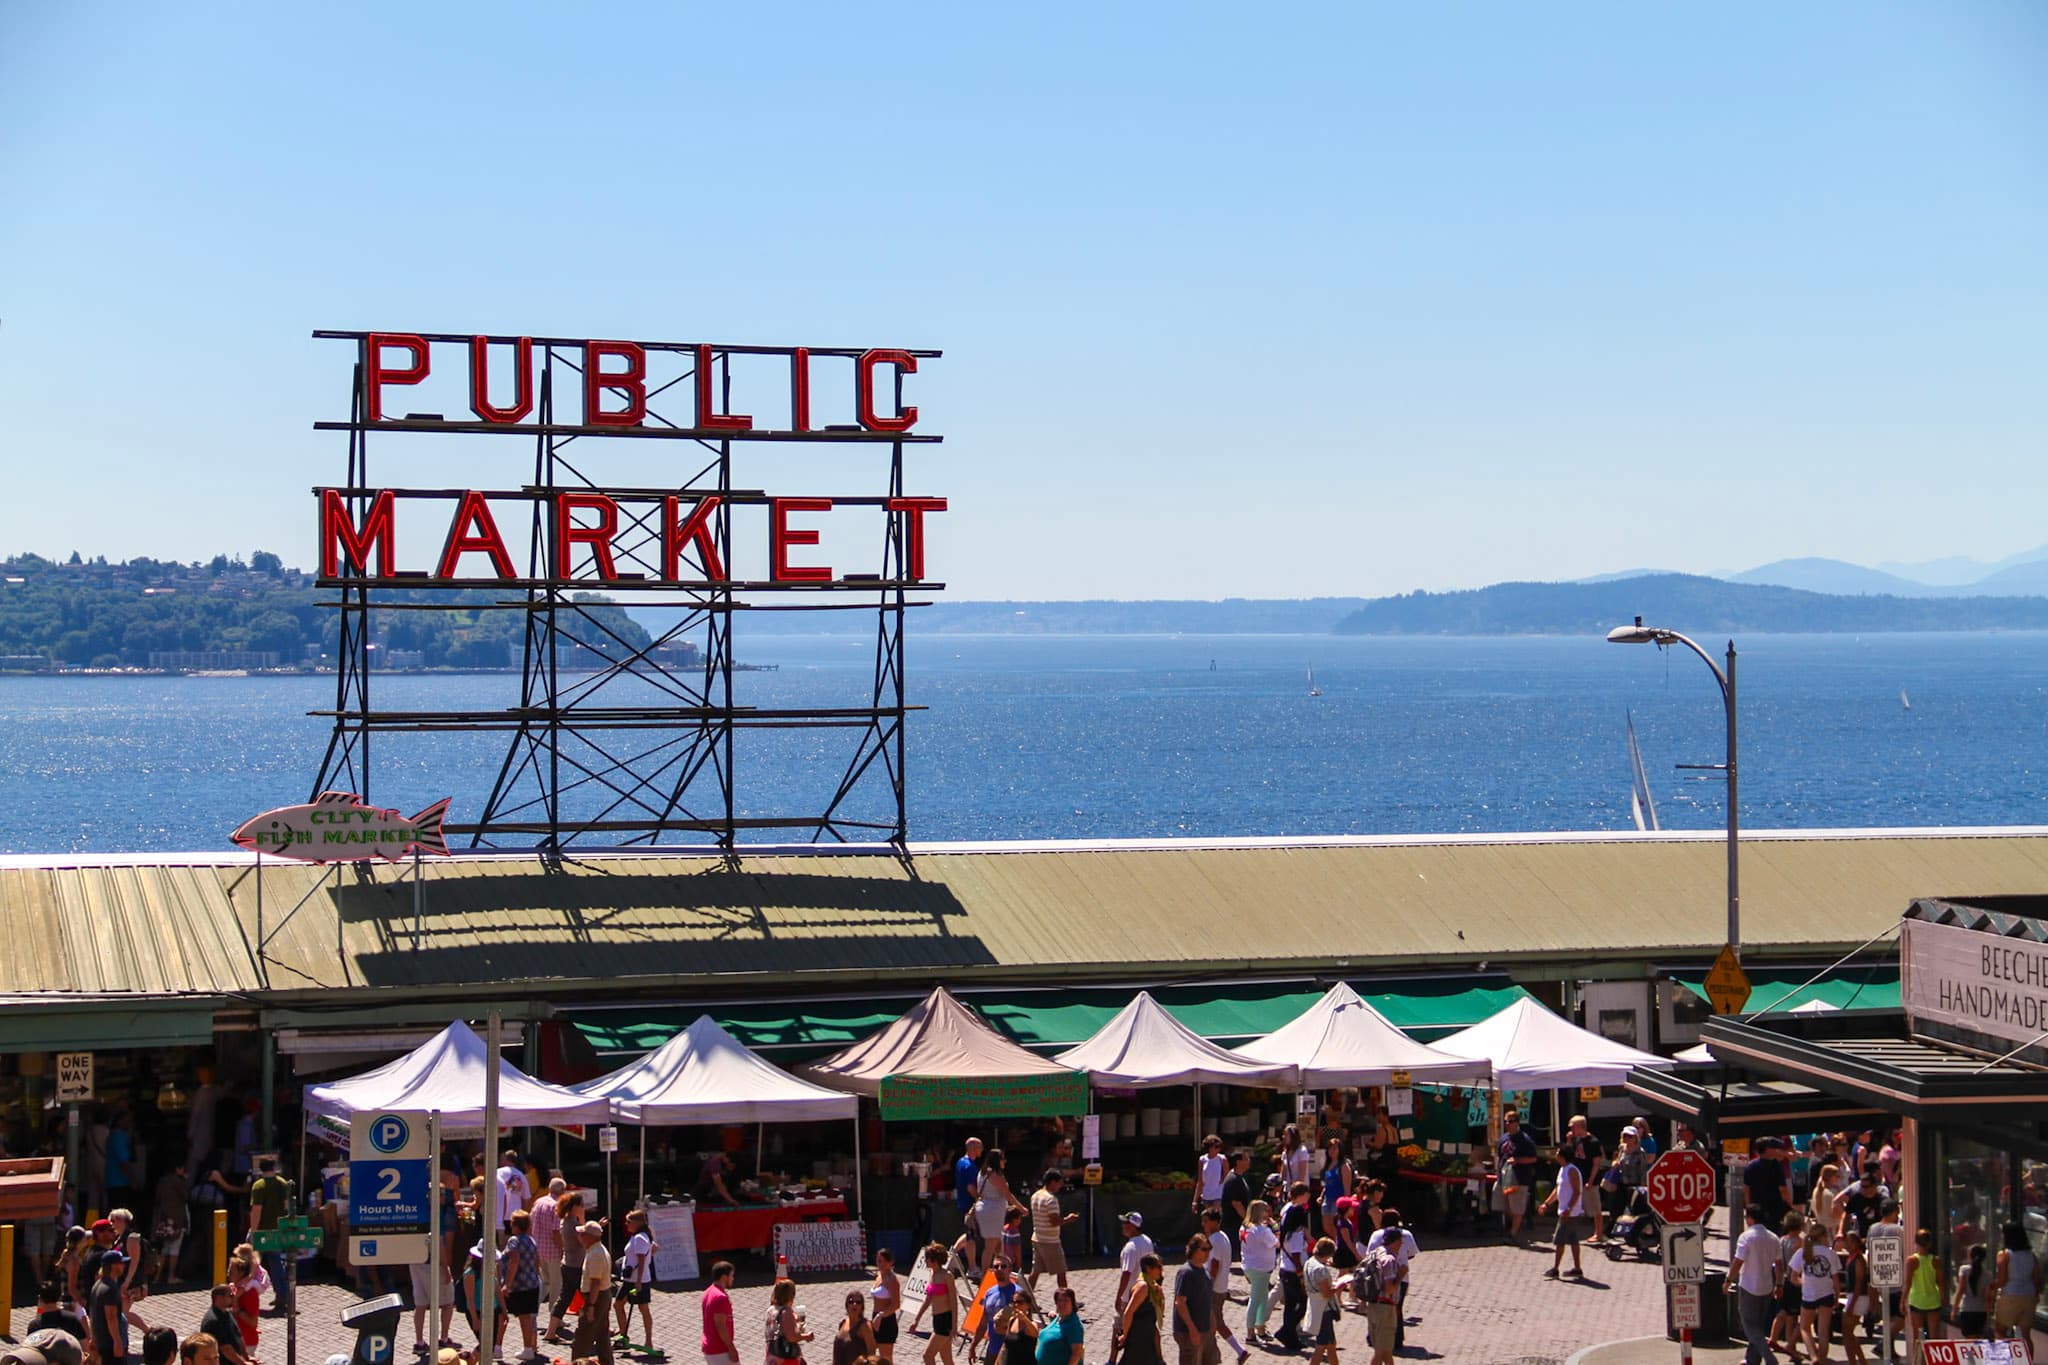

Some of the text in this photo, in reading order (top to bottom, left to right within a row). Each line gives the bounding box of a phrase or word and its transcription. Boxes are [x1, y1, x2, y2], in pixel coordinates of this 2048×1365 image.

[364, 332, 919, 433] PUBLIC
[318, 489, 948, 582] MARKET
[310, 810, 375, 825] CITY
[256, 828, 424, 845] FISH MARKET
[1939, 978, 2048, 1032] HANDMADE
[61, 1056, 89, 1068] ONE
[60, 1070, 89, 1081] WAY
[382, 1123, 401, 1145] P
[376, 1168, 401, 1200] 2
[1652, 1173, 1710, 1200] STOP
[359, 1204, 418, 1214] Hours Max
[802, 1231, 834, 1240] FRESH
[1875, 1243, 1896, 1251] POLICE
[1668, 1266, 1700, 1280] ONLY
[370, 1336, 387, 1361] P
[1928, 1346, 1954, 1363] NO
